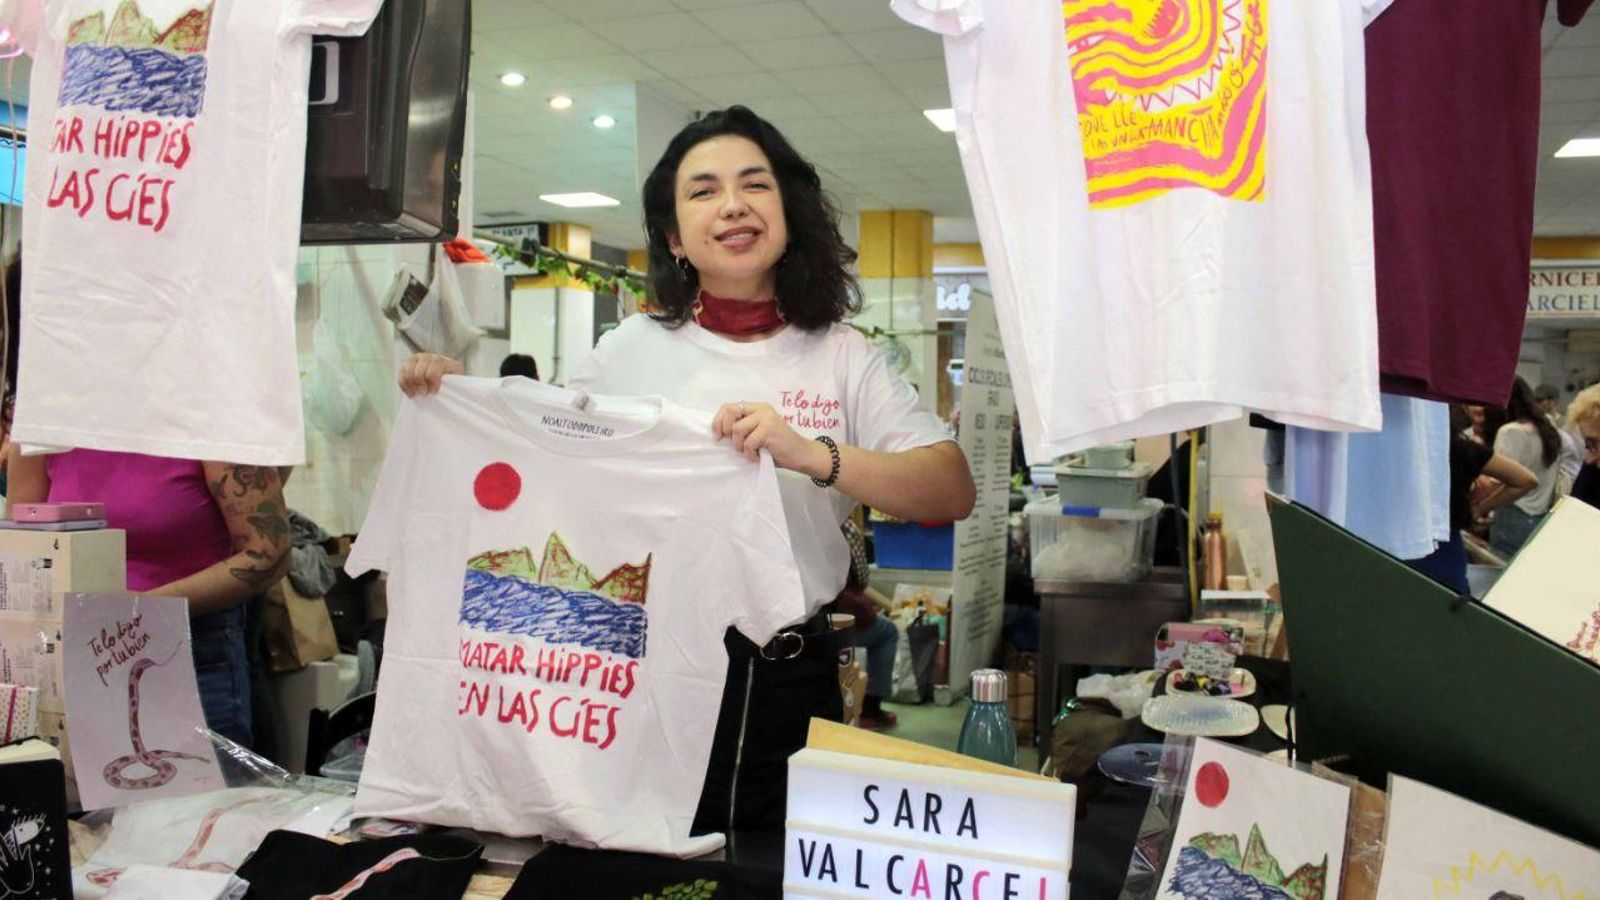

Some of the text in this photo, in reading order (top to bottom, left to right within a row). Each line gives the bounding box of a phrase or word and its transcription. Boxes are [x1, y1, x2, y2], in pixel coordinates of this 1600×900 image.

[47, 166, 99, 218] LAS
[497, 685, 541, 733] LAS
[863, 784, 979, 840] SARA
